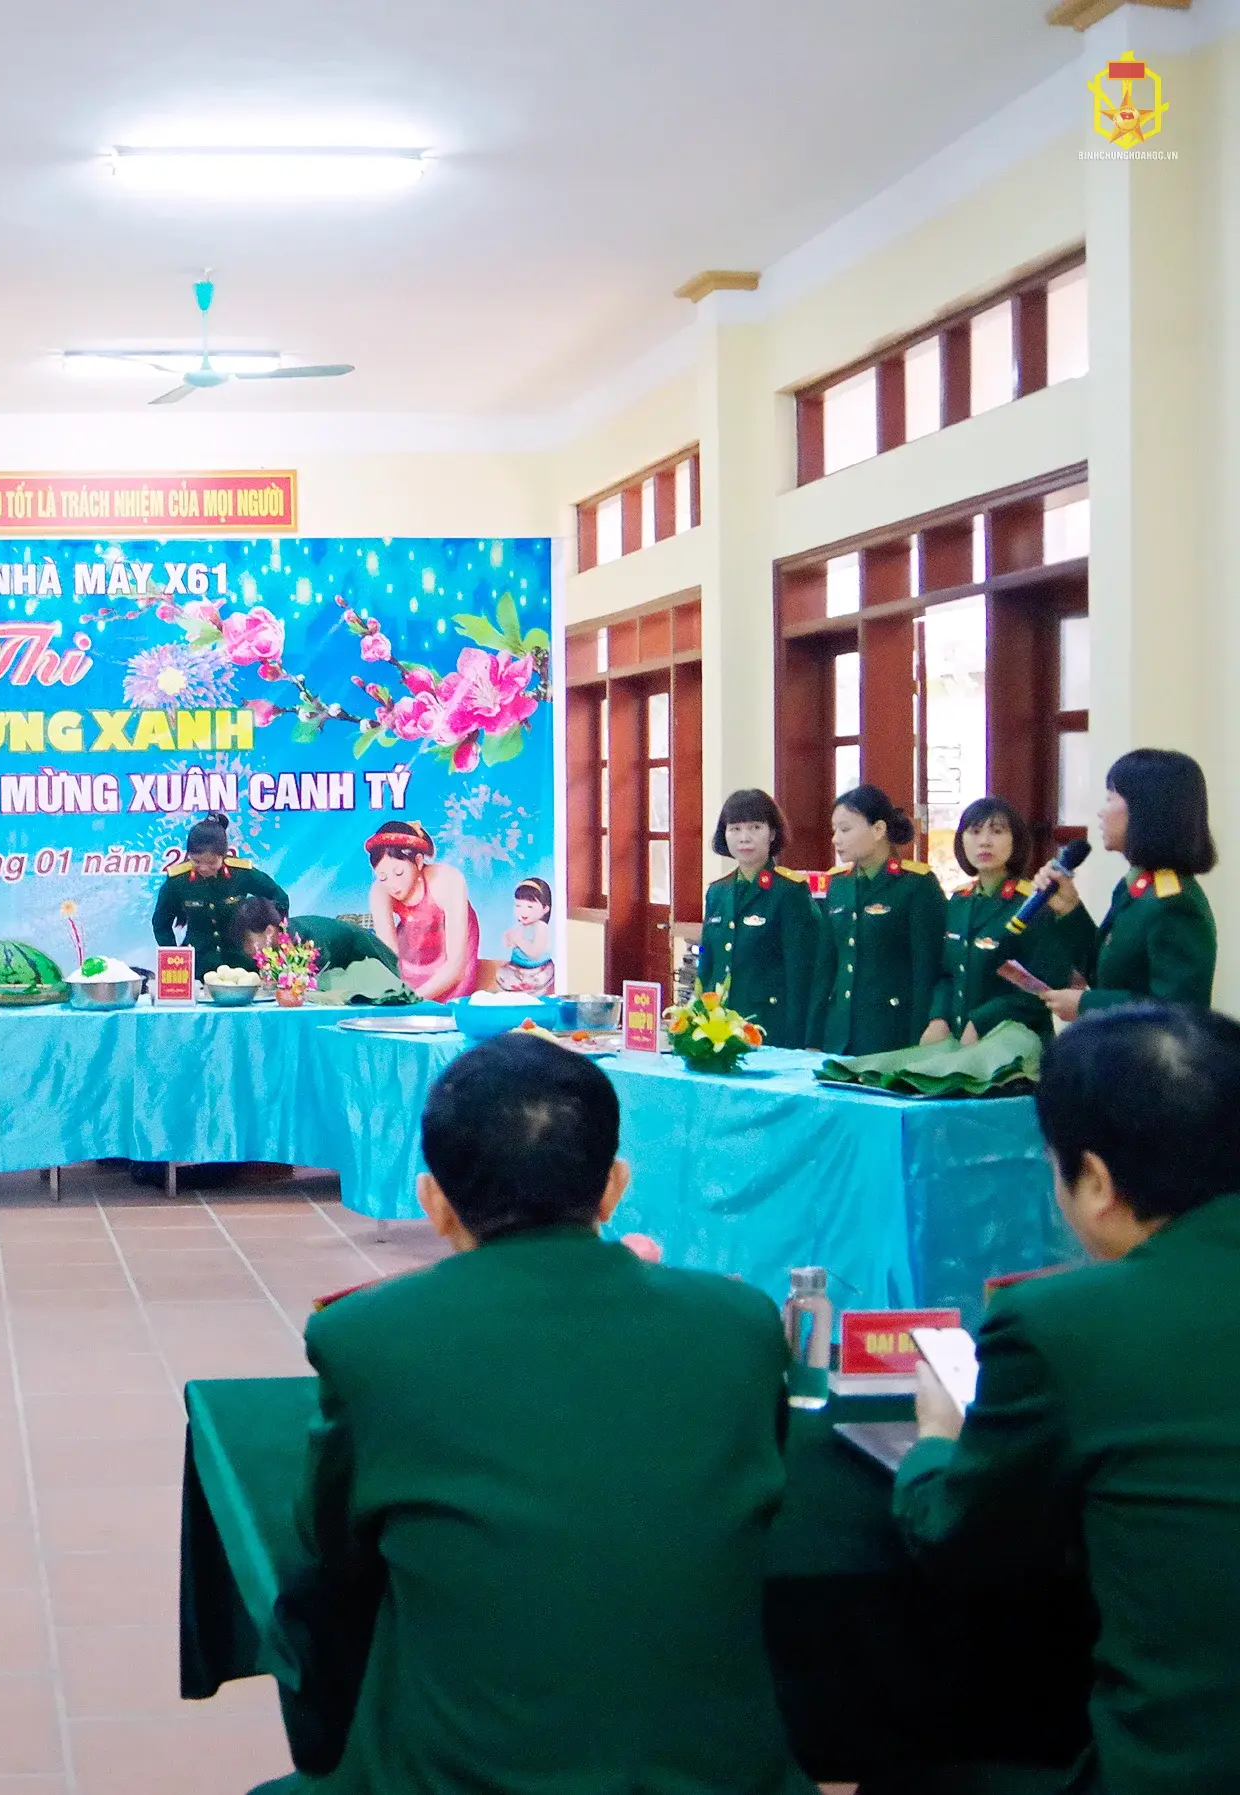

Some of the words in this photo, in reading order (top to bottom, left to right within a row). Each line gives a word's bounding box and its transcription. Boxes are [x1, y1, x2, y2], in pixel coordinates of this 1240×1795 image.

[5, 481, 33, 518] TỐT
[37, 484, 57, 518] LÀ
[61, 484, 110, 518] TRÁCH
[114, 484, 164, 524] NHIỆM
[168, 480, 199, 518] CỦA
[204, 489, 233, 523] MỌI
[237, 481, 284, 518] NGƯỜI
[74, 556, 154, 595] MÁY
[163, 562, 227, 595] X61
[88, 708, 254, 752] XANH
[0, 767, 119, 815] MỪNG
[128, 765, 239, 813] XUÂN
[248, 771, 355, 812] CANH
[365, 764, 412, 810] TÝ
[37, 850, 71, 874] 01
[84, 847, 151, 874] năm
